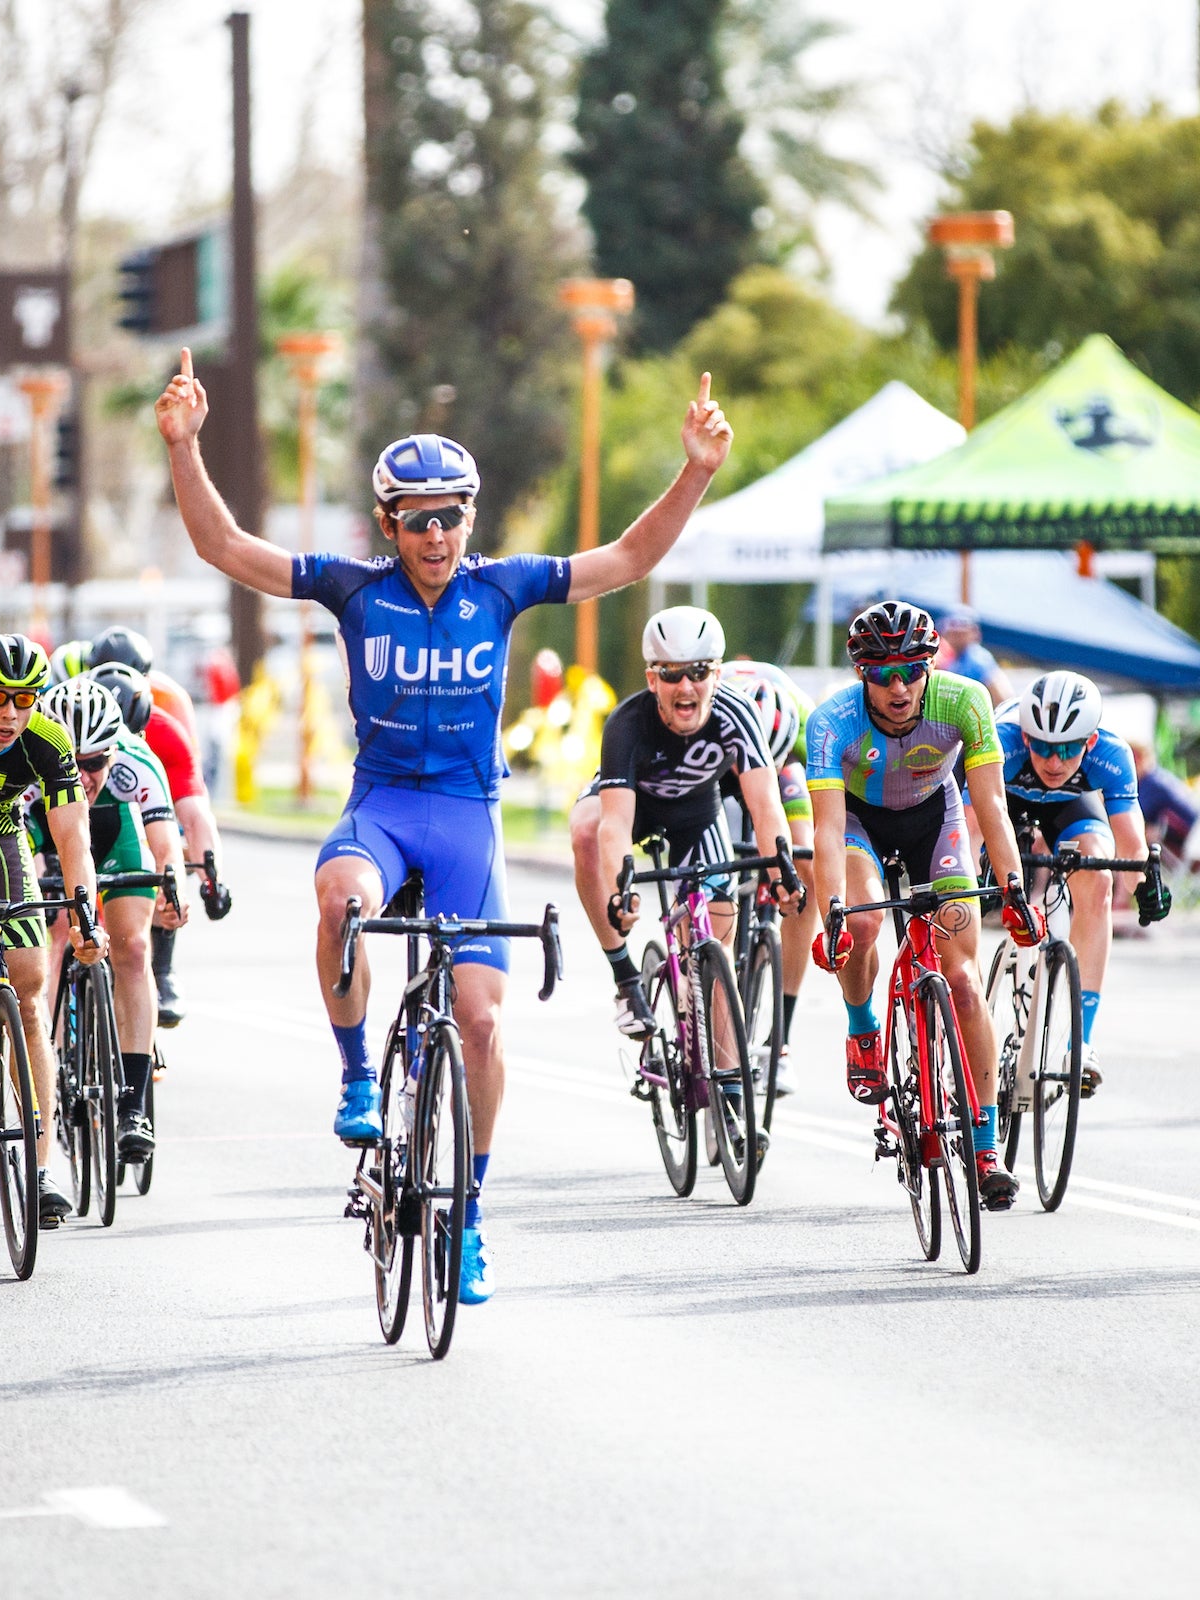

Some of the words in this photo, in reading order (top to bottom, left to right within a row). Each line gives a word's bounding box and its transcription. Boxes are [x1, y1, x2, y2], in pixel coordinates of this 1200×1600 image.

[375, 598, 421, 615] ORBEA
[394, 641, 494, 681] UHC
[394, 682, 491, 696] UnitedHealthcare
[370, 716, 418, 731] SHIMANO
[438, 721, 475, 732] SMITH
[23, 876, 36, 902] BIKE
